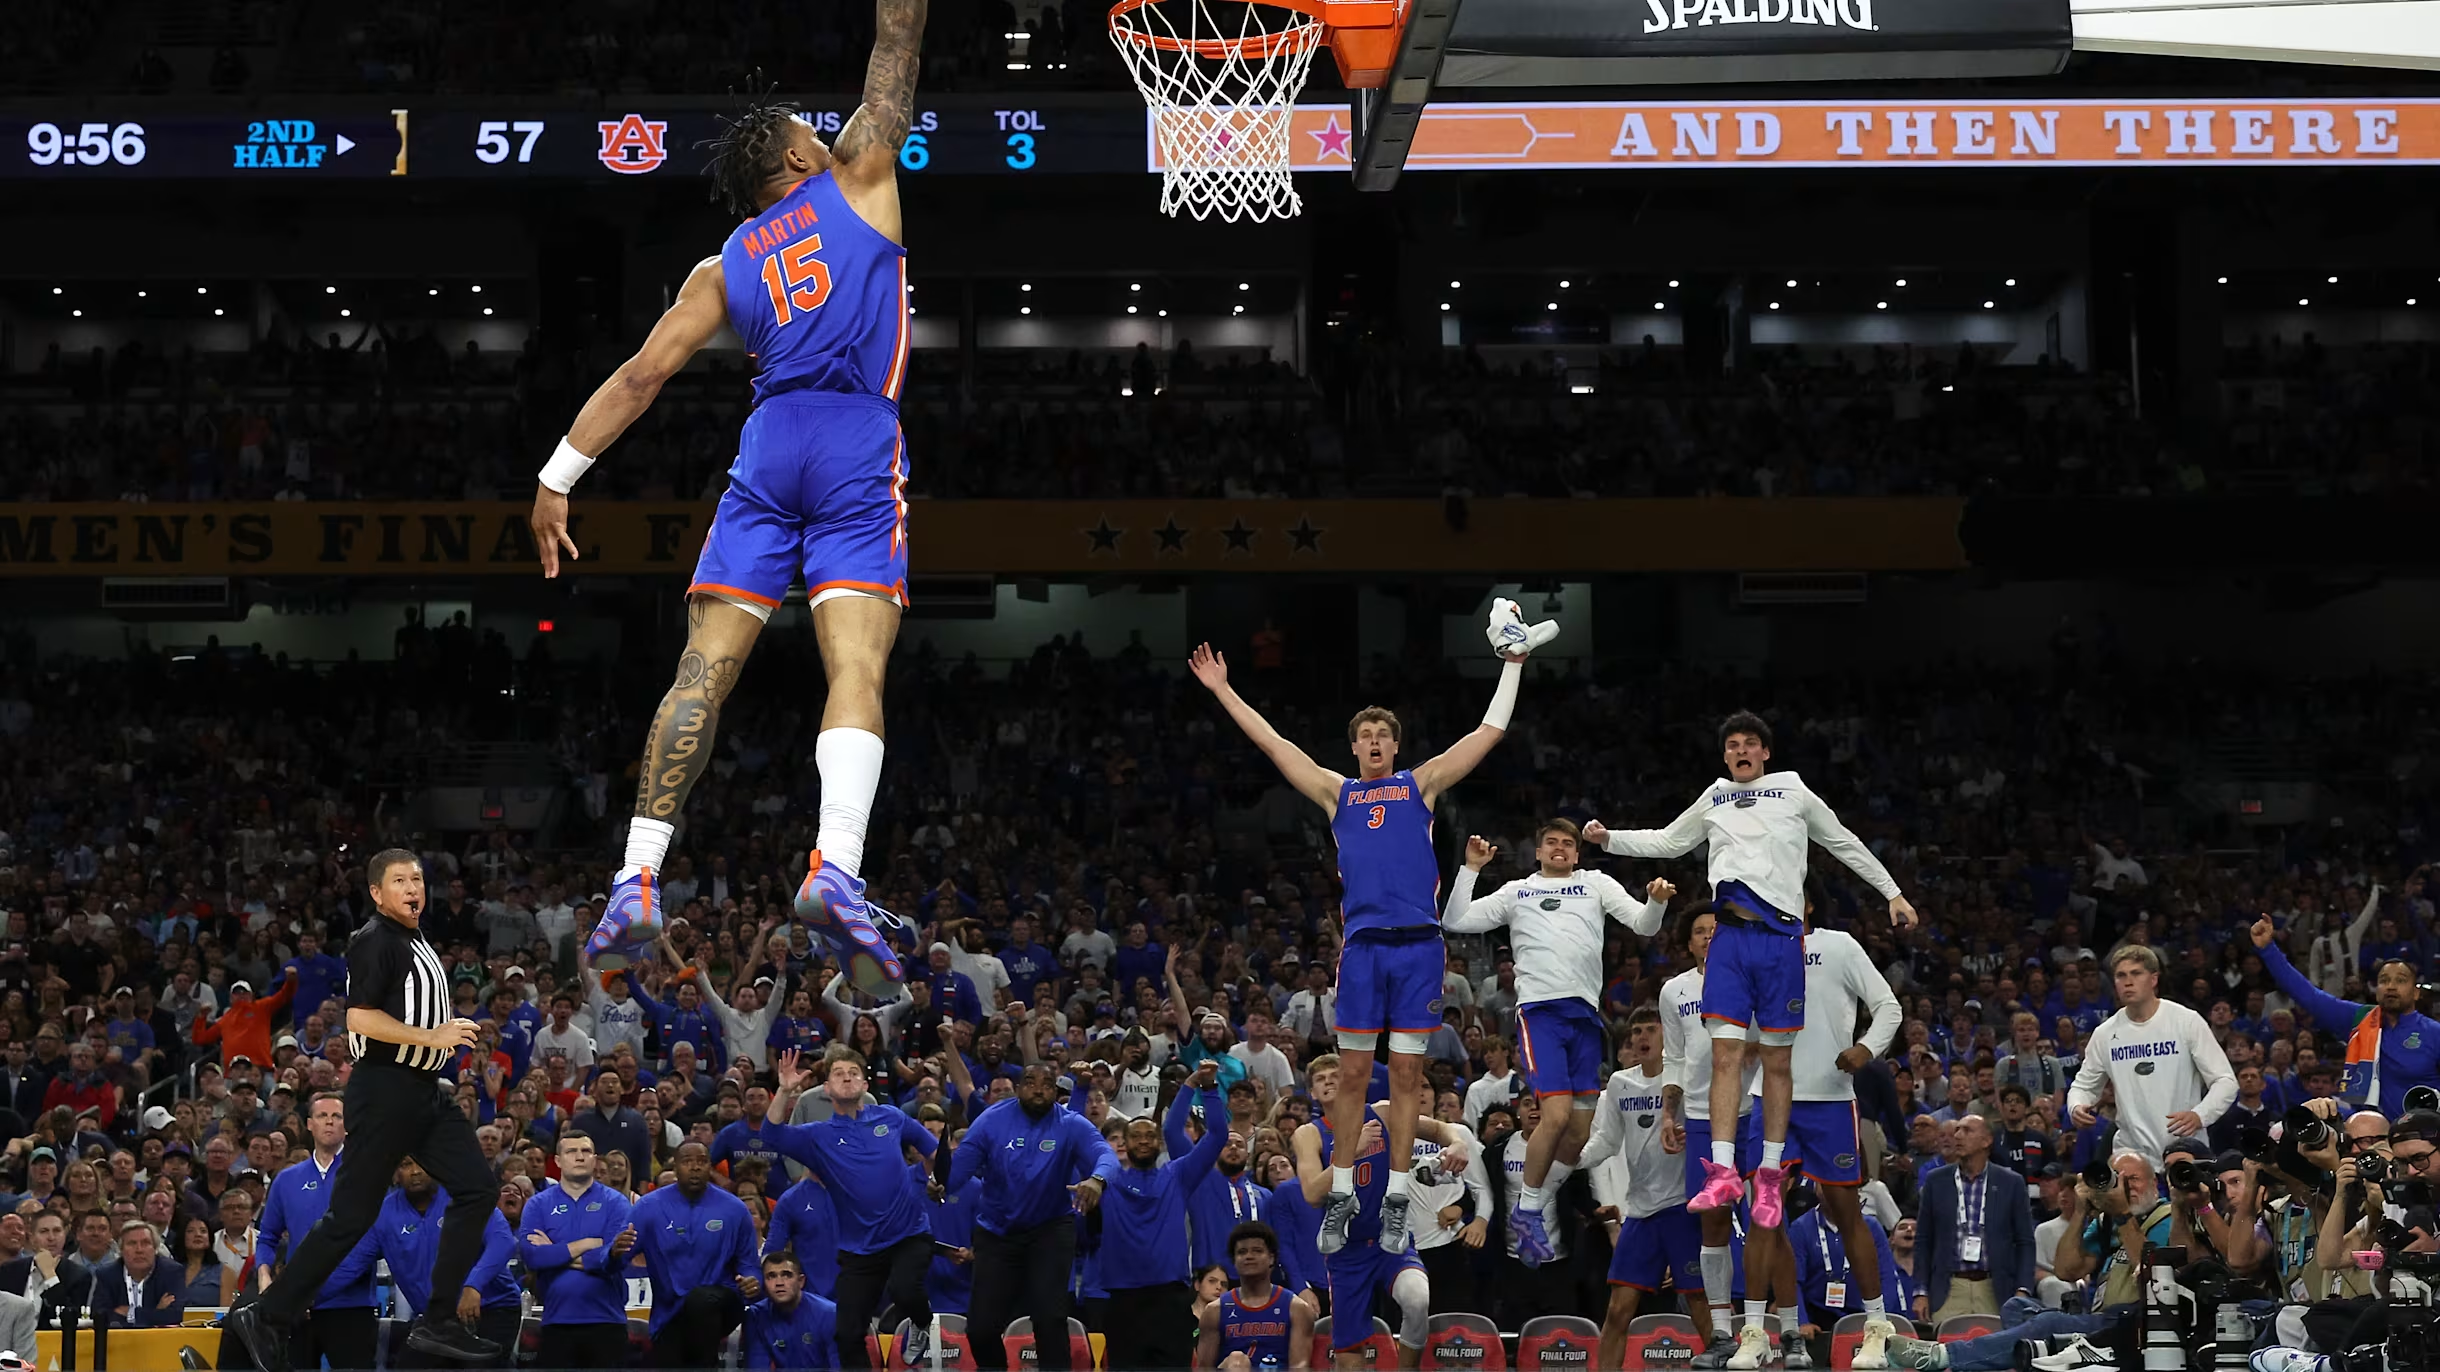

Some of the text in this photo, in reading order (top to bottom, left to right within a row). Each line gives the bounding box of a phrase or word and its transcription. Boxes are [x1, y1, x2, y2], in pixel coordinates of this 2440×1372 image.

[248, 120, 315, 142] 2ND
[994, 110, 1046, 131] TOL
[27, 122, 146, 166] 9:56
[475, 121, 545, 164] 57
[1611, 109, 2399, 157] AND THEN THERE
[233, 144, 327, 168] HALF
[1006, 133, 1036, 170] 3
[742, 201, 819, 260] MARTIN
[760, 232, 833, 327] 15
[1346, 785, 1410, 807] FLORIDA
[1366, 804, 1386, 830] 3
[2110, 1040, 2180, 1062] NOTHING EASY.
[1618, 1095, 1654, 1112] NOTHING
[1225, 1321, 1286, 1337] FLORIDA
[1436, 1347, 1483, 1358] FINAL FOUR
[1541, 1350, 1587, 1361] FINAL FOUR
[1644, 1348, 1691, 1359] FINAL FOUR
